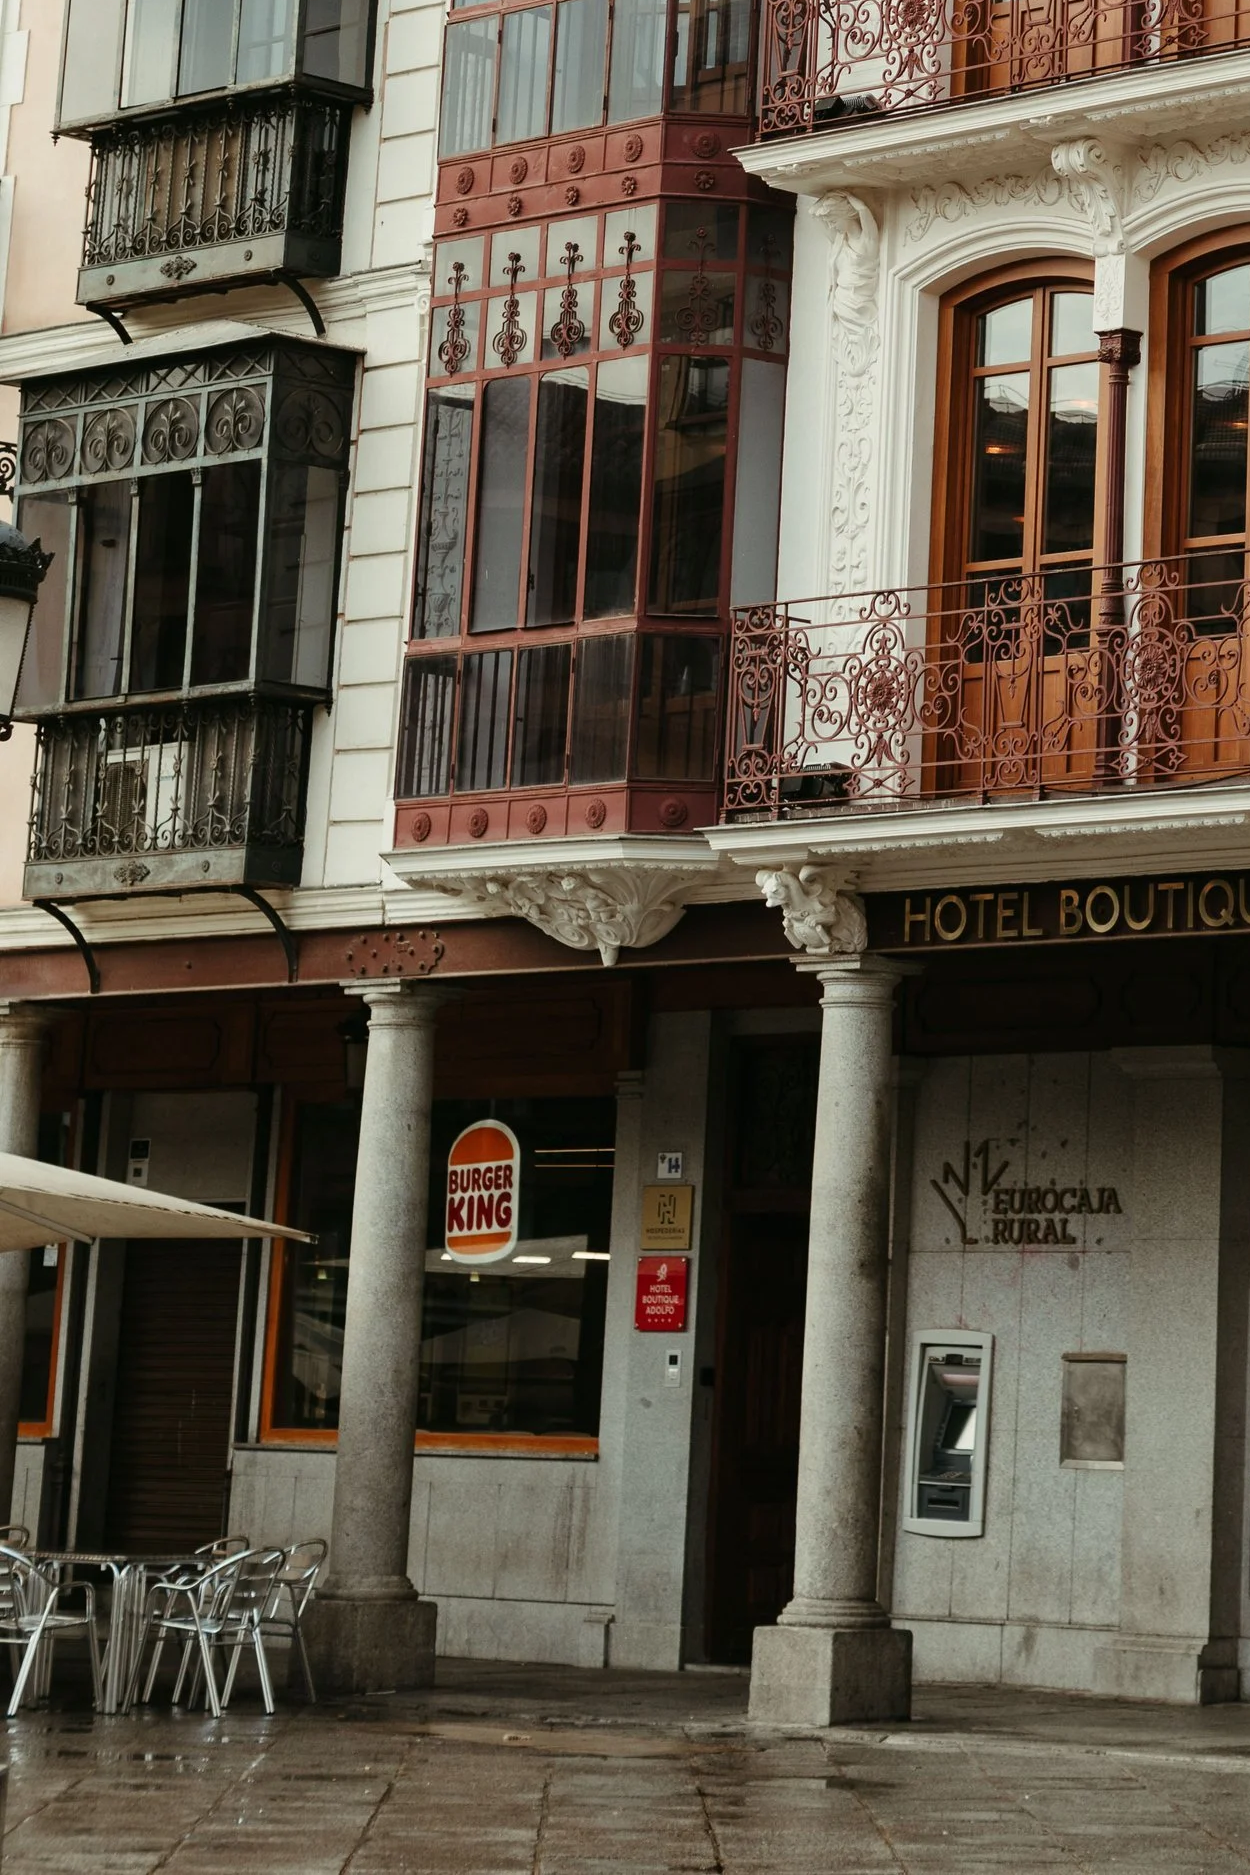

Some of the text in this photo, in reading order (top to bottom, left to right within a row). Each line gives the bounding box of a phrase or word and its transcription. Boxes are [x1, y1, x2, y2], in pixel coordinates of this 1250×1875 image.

[903, 890, 1044, 943] HOTEL
[448, 1164, 514, 1195] BURGER
[446, 1191, 513, 1233] KING
[992, 1187, 1123, 1215] EUROCAJA
[991, 1217, 1076, 1245] RURAL
[642, 1294, 679, 1304] BOUTIQUE
[650, 1284, 672, 1293] HOTEL
[645, 1306, 675, 1315] ADOLFO
